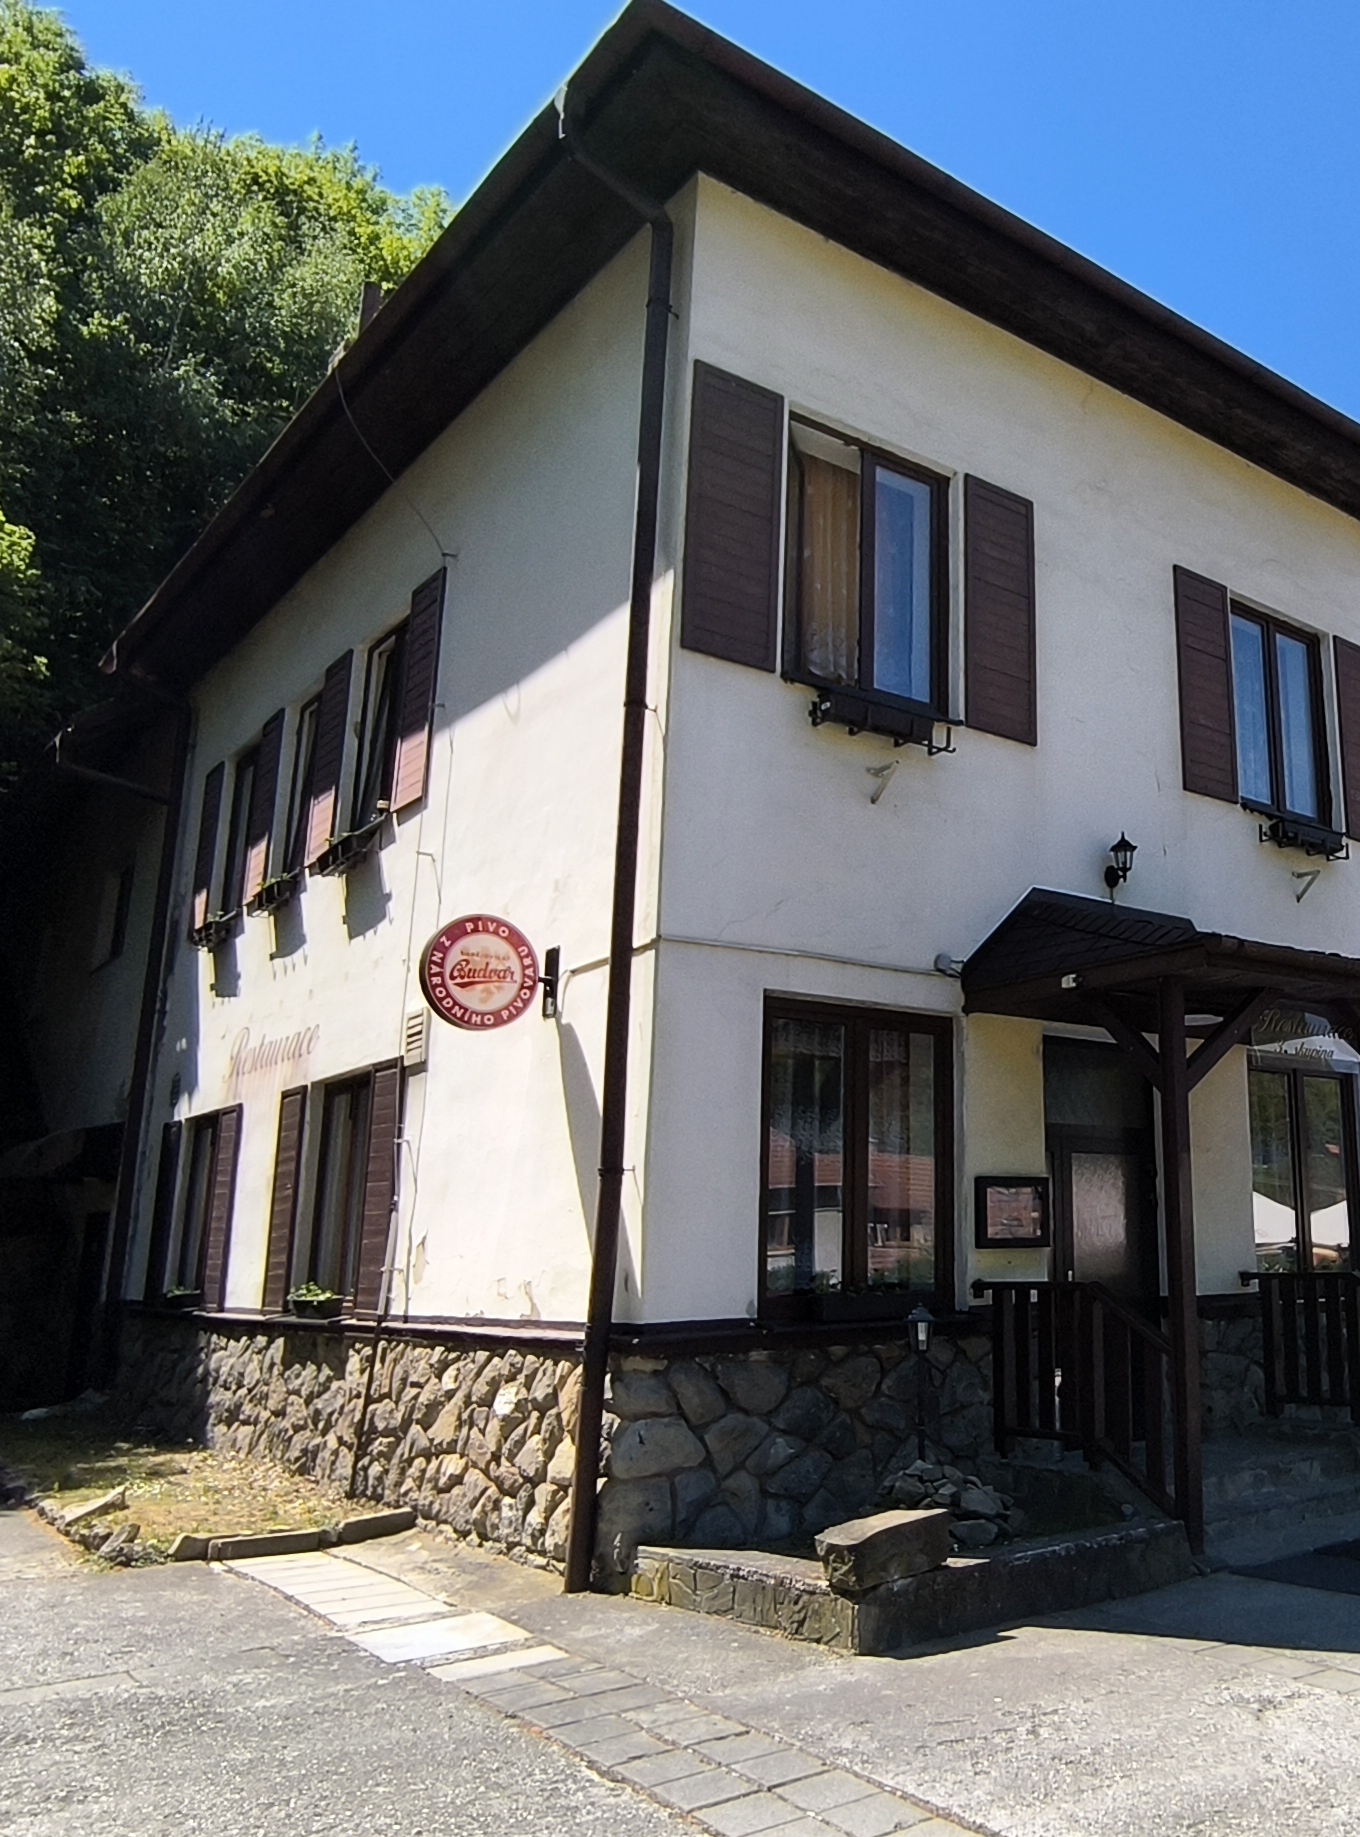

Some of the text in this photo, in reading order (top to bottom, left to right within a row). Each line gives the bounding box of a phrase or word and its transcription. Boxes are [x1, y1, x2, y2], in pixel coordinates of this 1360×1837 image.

[465, 921, 509, 937] PIVO
[430, 935, 534, 1025] Z NÁRODNÍHO PIVOVARU
[448, 958, 518, 984] Budvar
[222, 1023, 321, 1084] Restaurace
[1294, 1041, 1335, 1061] skupina
